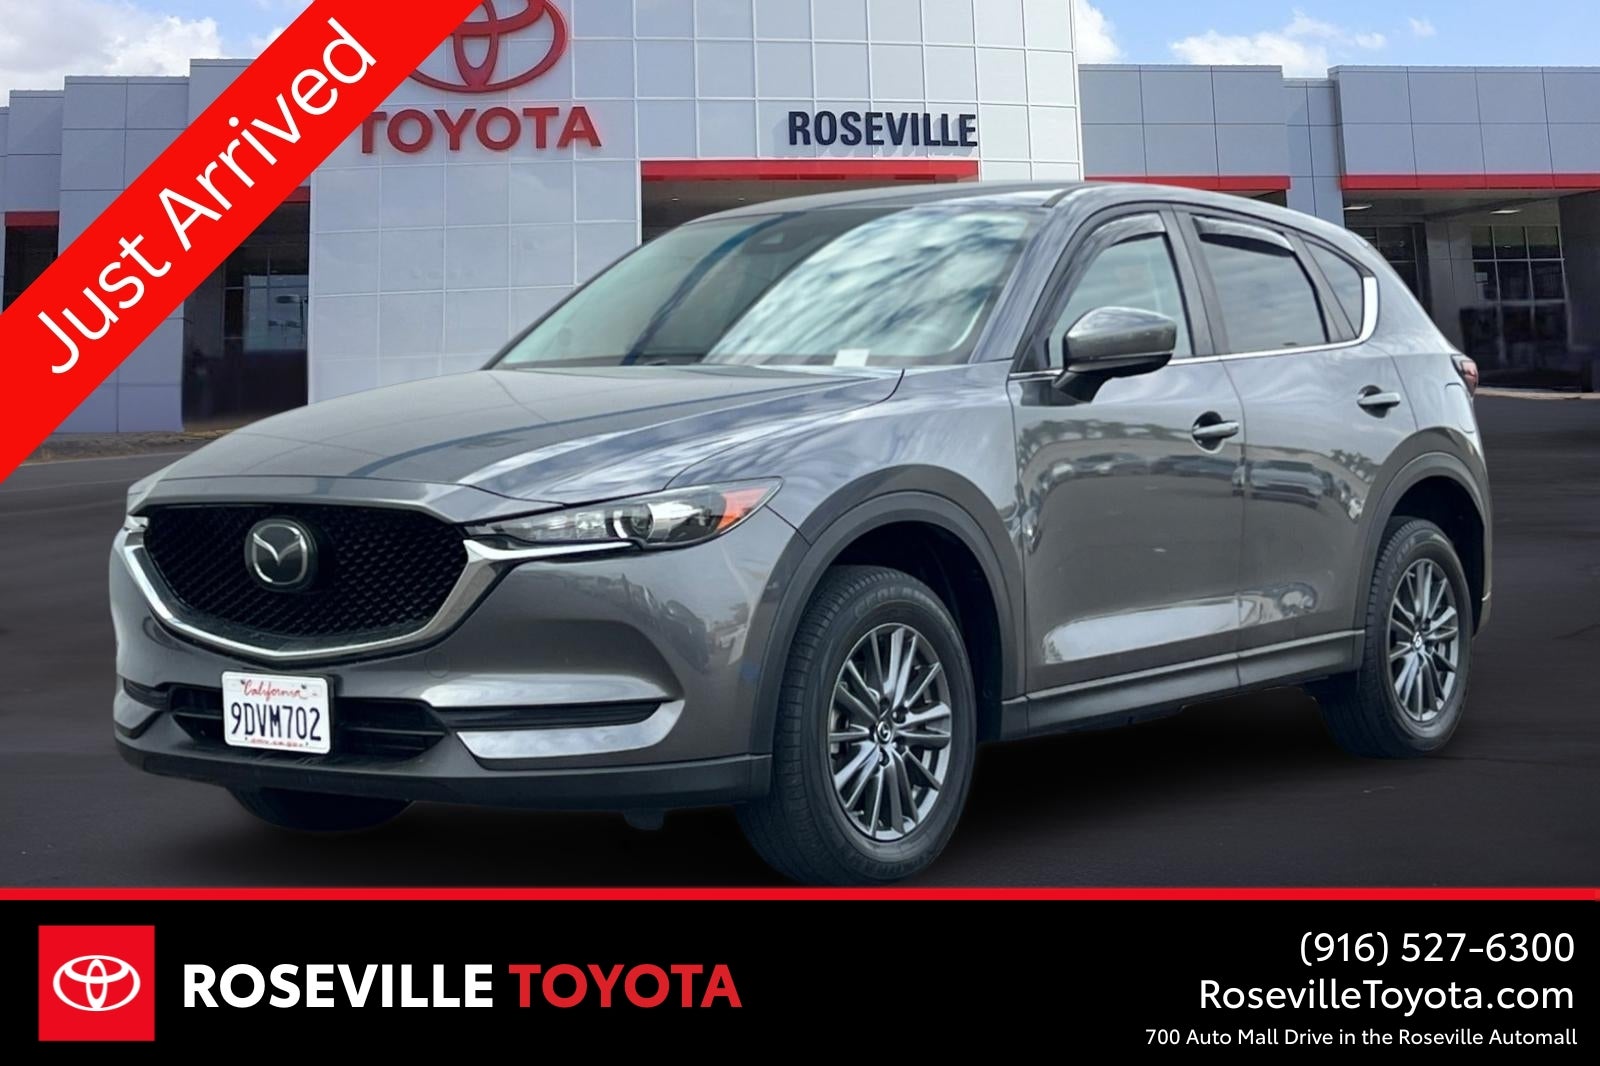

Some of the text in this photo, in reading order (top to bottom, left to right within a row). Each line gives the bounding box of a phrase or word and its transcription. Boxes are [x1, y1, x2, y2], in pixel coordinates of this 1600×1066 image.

[361, 106, 602, 154] TOYOTA
[788, 110, 978, 147] ROSEVILLE
[243, 679, 302, 702] California
[231, 702, 322, 742] 9DVM702
